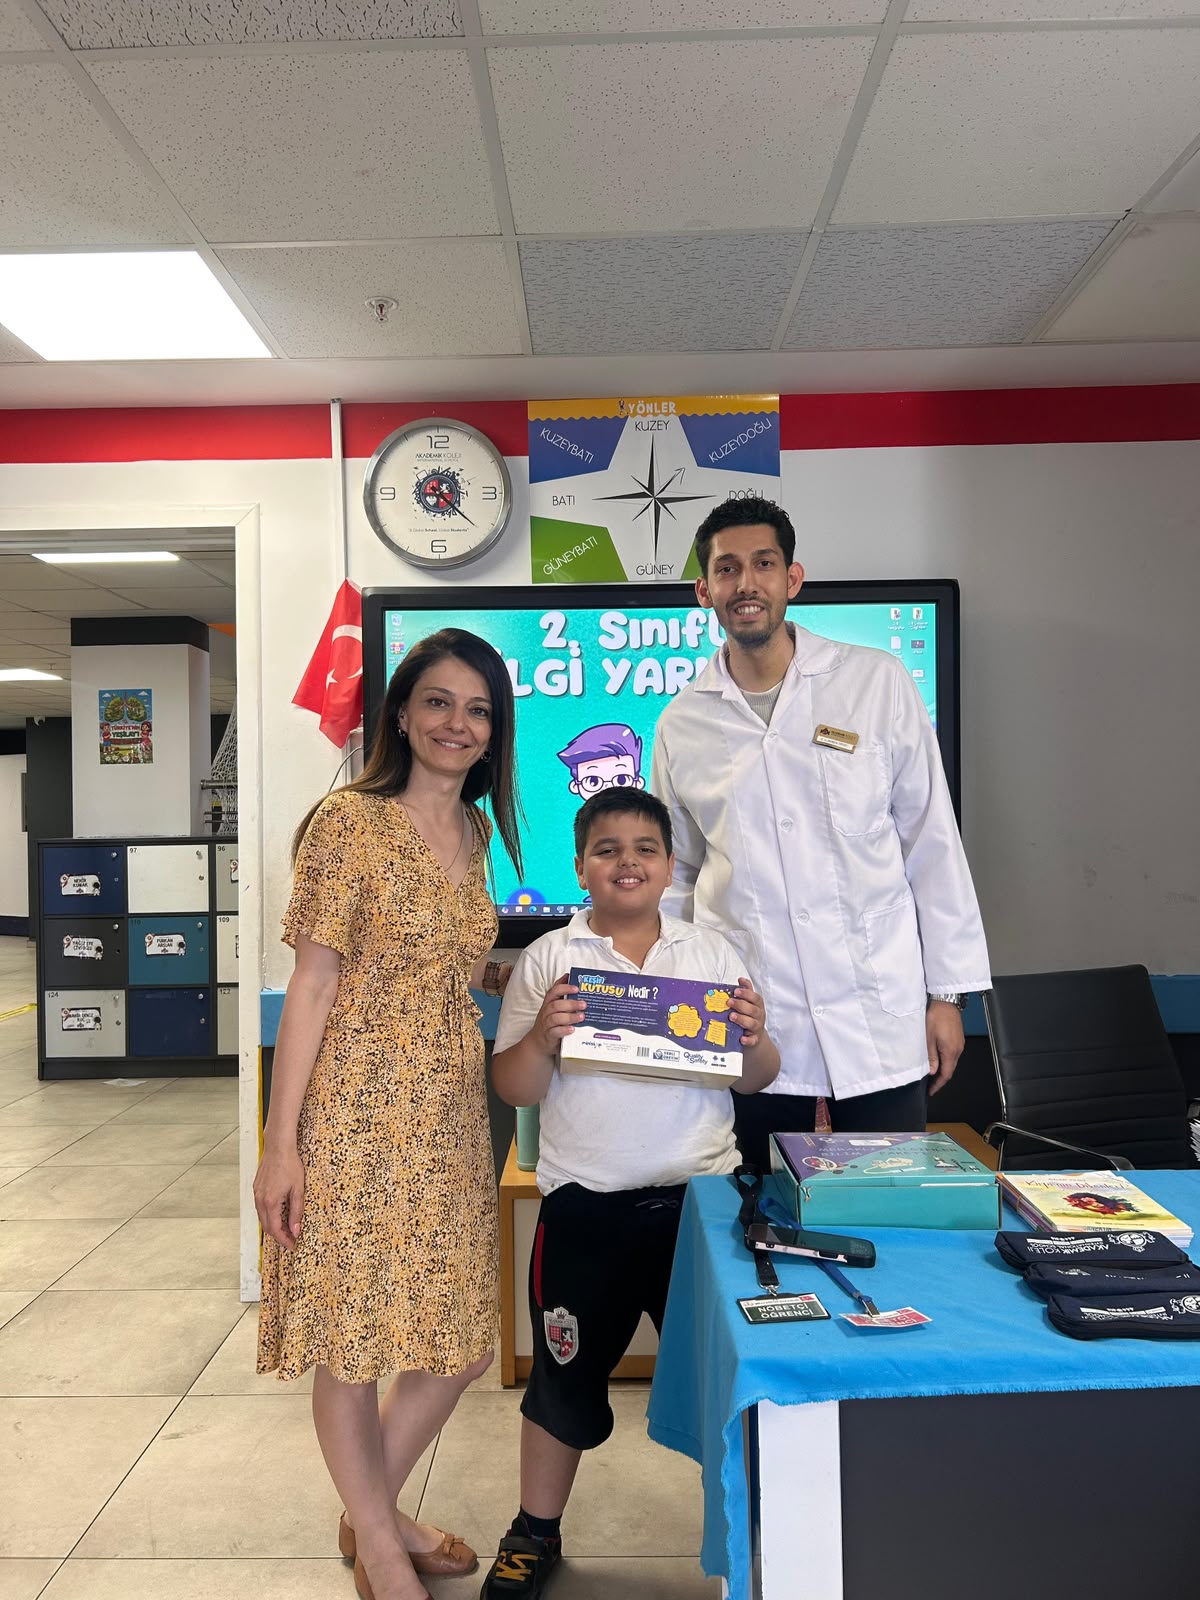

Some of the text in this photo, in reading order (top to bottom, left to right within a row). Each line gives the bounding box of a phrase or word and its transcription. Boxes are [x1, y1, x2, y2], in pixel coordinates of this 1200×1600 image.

[628, 401, 677, 414] YÖNLER
[635, 420, 670, 431] KUZEY
[426, 435, 449, 449] 12
[540, 427, 594, 463] KUZEYBATI
[708, 418, 772, 463] KUZEYDOĞU
[380, 487, 396, 500] 9
[482, 486, 497, 500] 3
[728, 487, 764, 500] DOĞU
[552, 495, 575, 506] BATI
[431, 540, 447, 553] 6
[542, 535, 598, 575] GÜNEYBATI
[636, 563, 674, 575] GÜNEY
[539, 609, 727, 650] 2. Sınıfl
[495, 646, 583, 697] LGİ
[580, 982, 659, 1000] KUTUSU Nedir ?
[683, 1051, 704, 1060] Quality
[757, 1302, 809, 1313] NÖBETÇİ
[760, 1308, 814, 1319] ÖĞRENCİ
